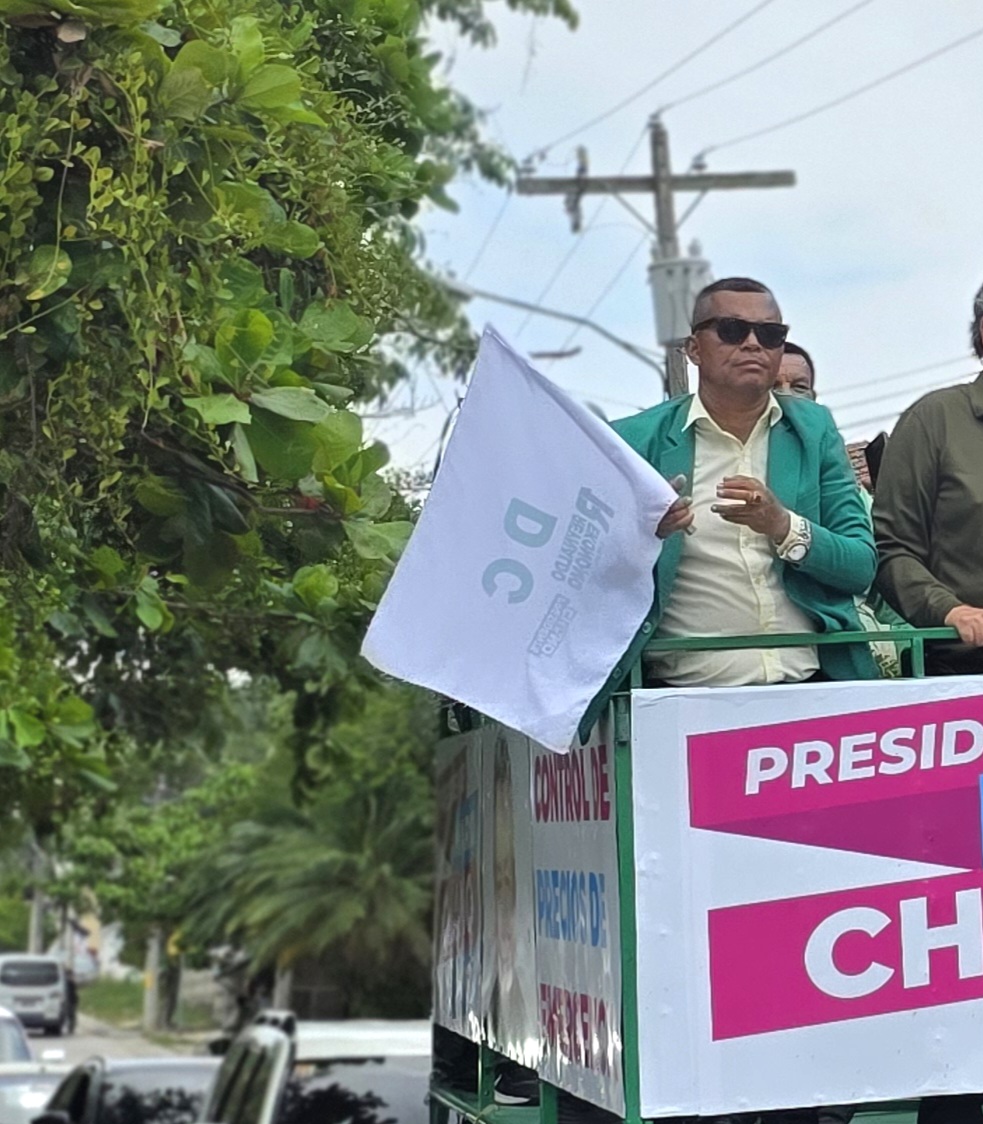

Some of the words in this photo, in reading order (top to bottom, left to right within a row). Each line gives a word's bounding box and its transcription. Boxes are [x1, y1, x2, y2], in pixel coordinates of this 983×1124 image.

[535, 749, 590, 823] CONTROL
[591, 745, 610, 821] DE
[536, 869, 588, 945] PRECIOS
[589, 871, 607, 949] DE
